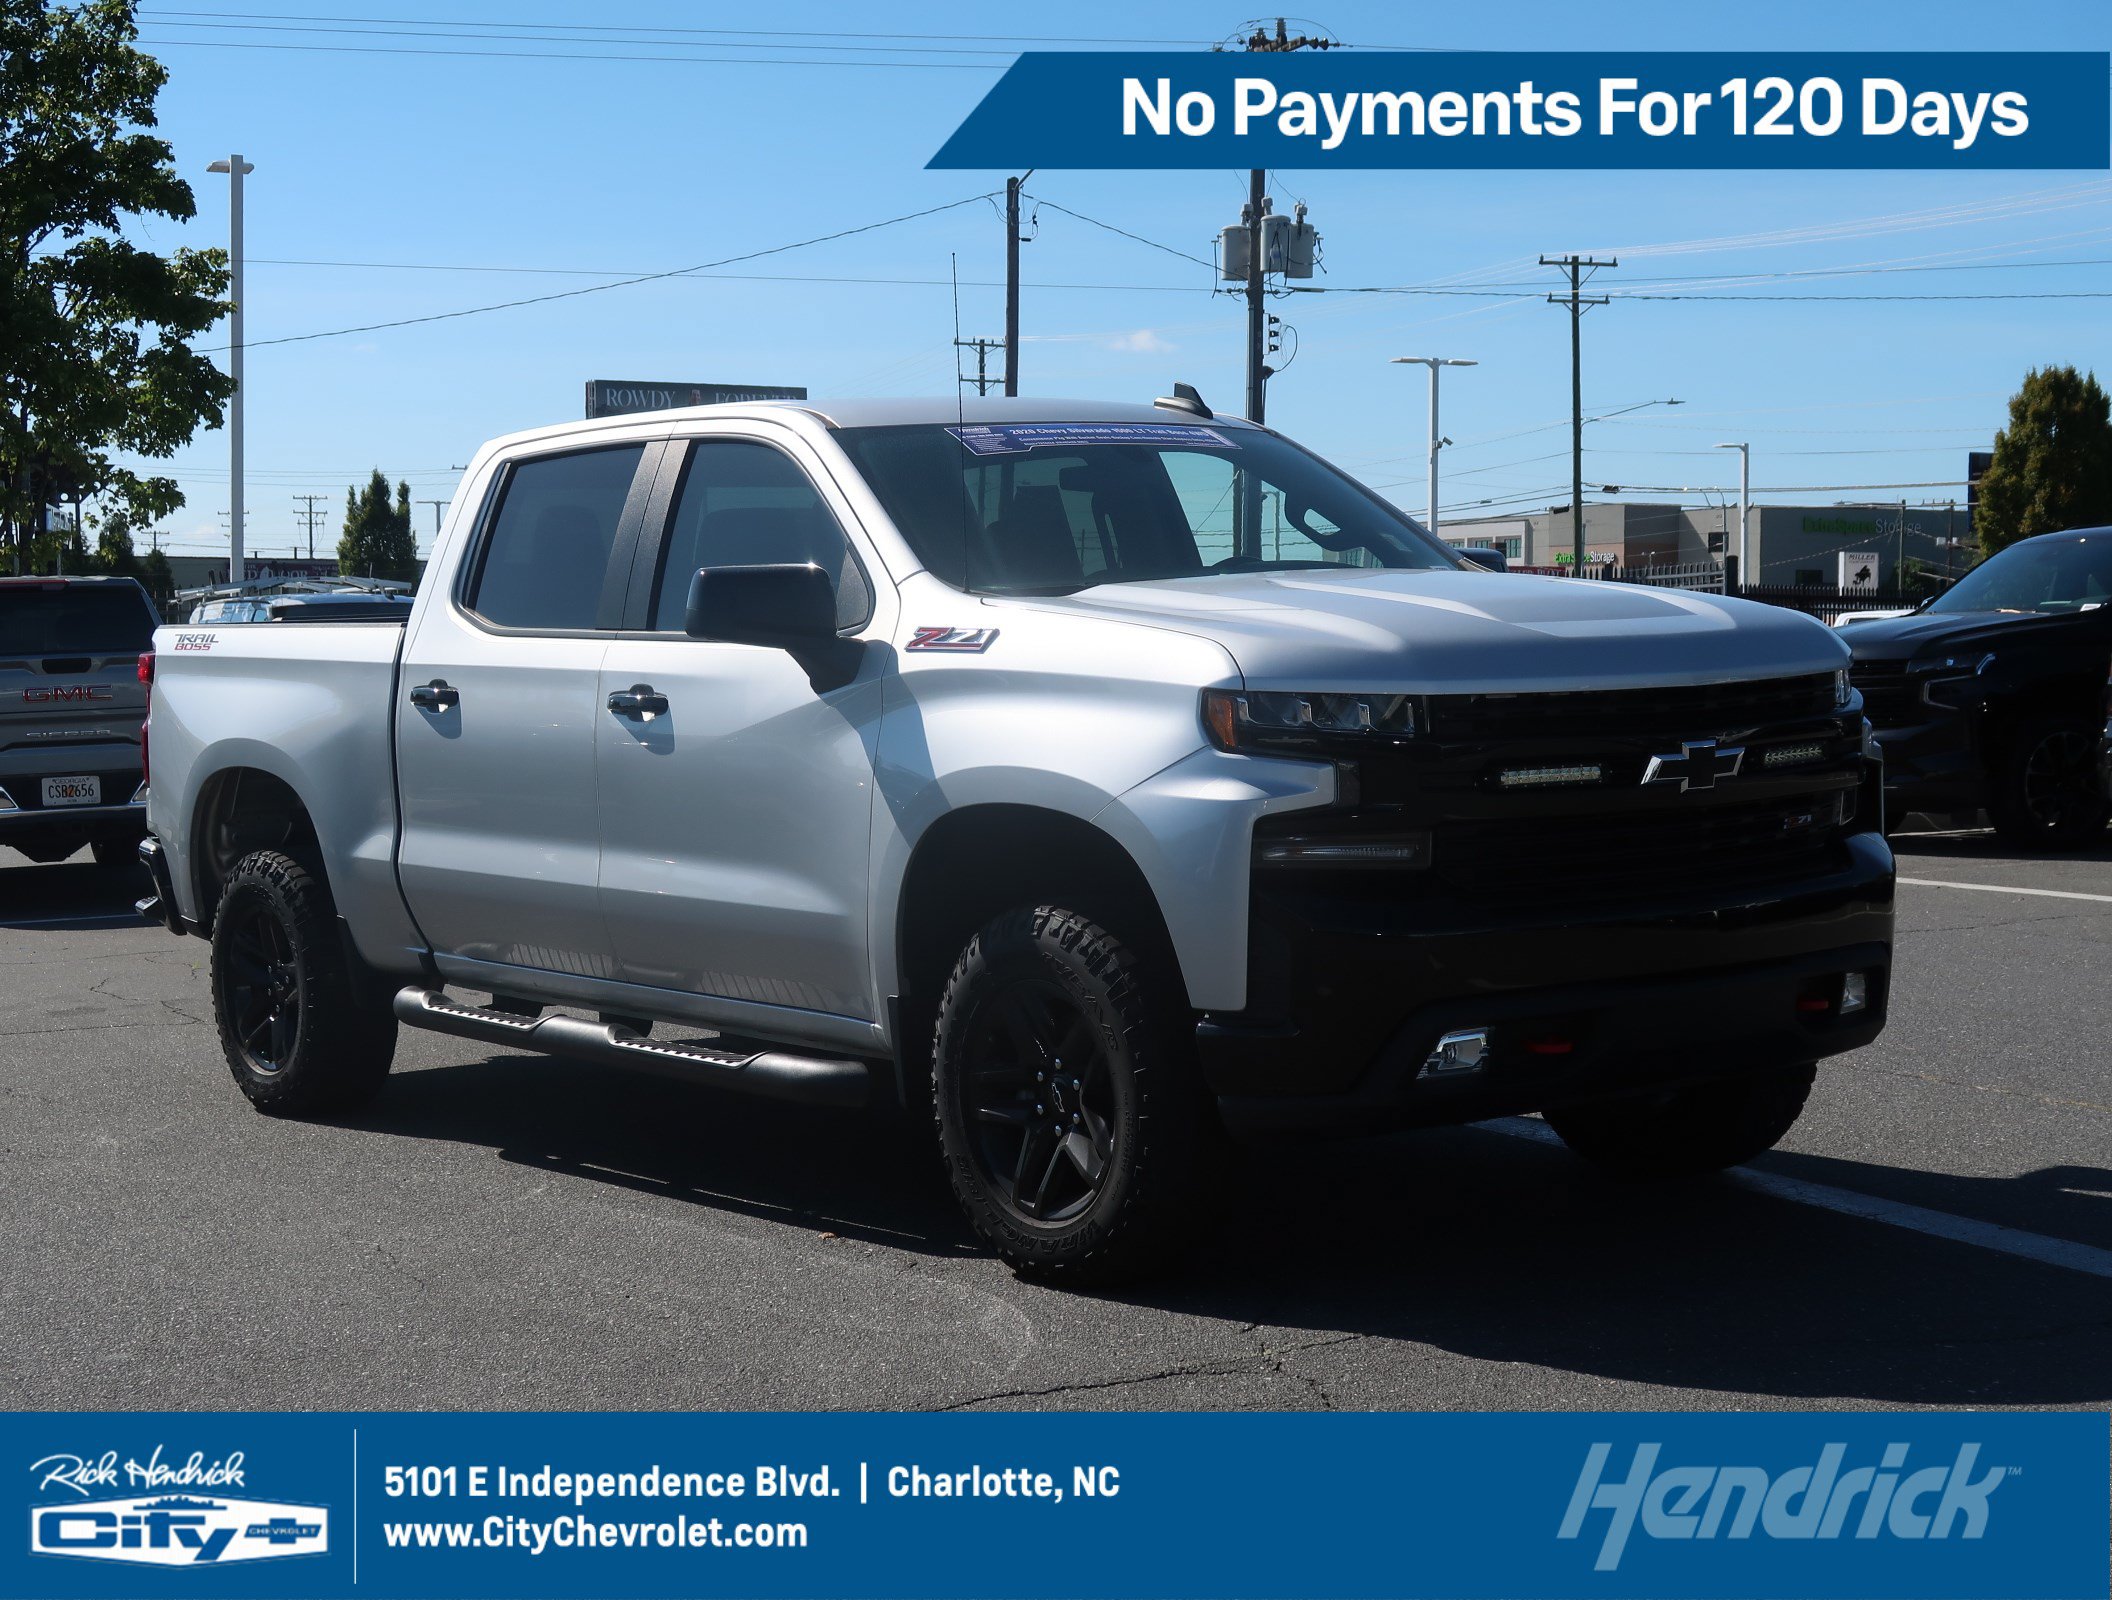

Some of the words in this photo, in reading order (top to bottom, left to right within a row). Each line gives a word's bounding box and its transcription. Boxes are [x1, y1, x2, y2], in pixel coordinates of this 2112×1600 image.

[606, 388, 676, 409] ROWDY
[1875, 518, 1922, 534] Storge
[1590, 550, 1615, 564] Storage
[1848, 553, 1876, 561] MILLER
[174, 633, 219, 643] TRAIL
[904, 626, 1000, 654] Z71
[174, 643, 211, 651] BOSS
[22, 684, 113, 703] GMC
[48, 783, 95, 799] CSB2656
